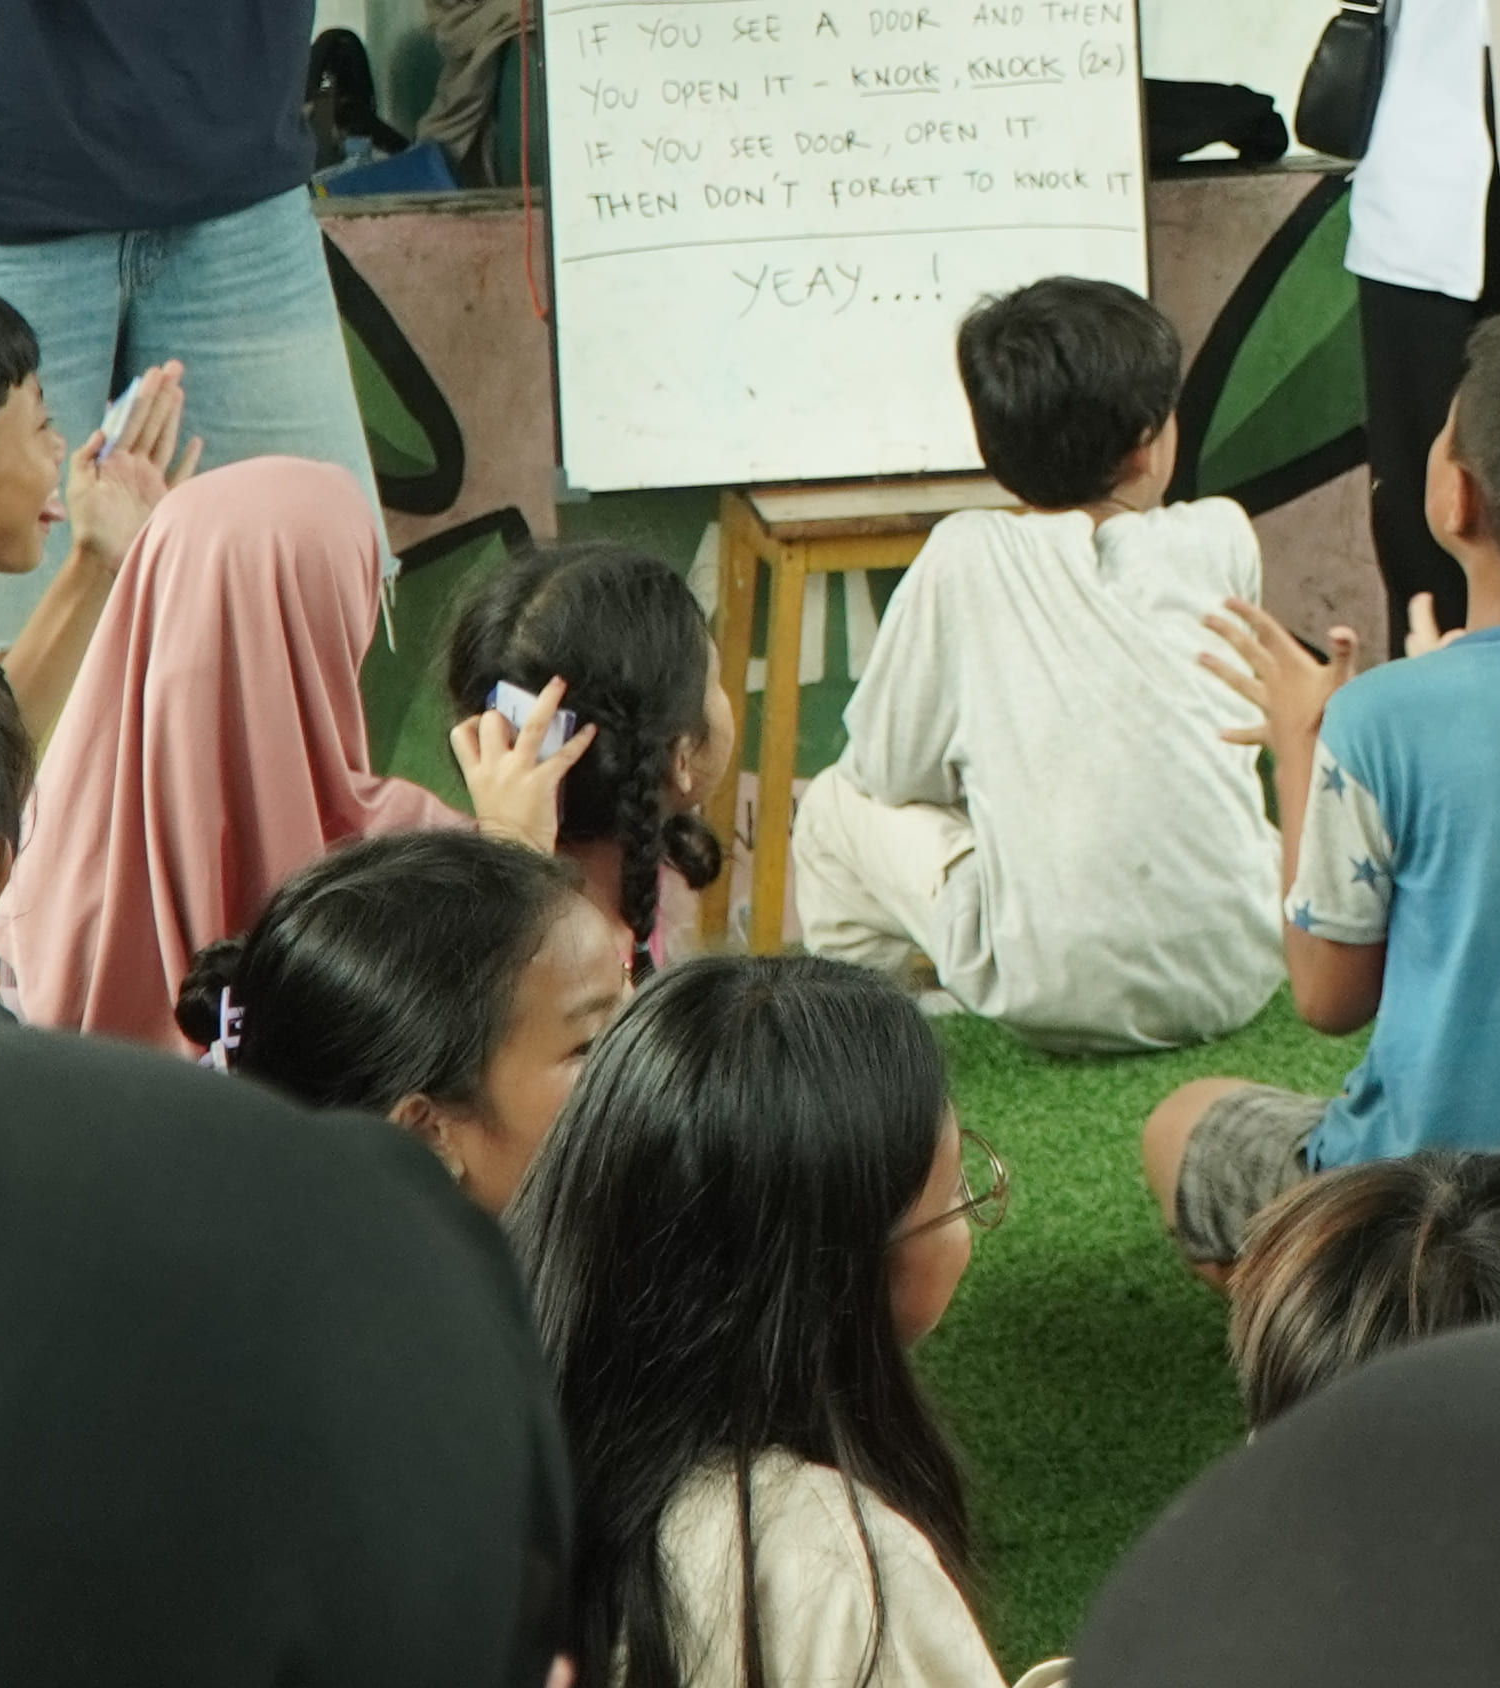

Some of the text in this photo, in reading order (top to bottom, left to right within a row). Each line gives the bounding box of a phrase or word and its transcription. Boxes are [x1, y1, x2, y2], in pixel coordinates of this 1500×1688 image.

[578, 1, 1124, 59] IF YOU SEE A DOOR AND THEN
[579, 83, 639, 115] YOU
[661, 79, 740, 104] OPEN
[763, 75, 794, 96] IT
[966, 55, 1063, 82] KNOCK
[584, 140, 615, 168] IF
[641, 137, 701, 164] YOU
[729, 136, 774, 159] SEE
[905, 119, 978, 146] OPEN
[1005, 115, 1036, 140] IT
[586, 190, 679, 222] THEN
[704, 172, 799, 209] DON'T
[828, 174, 943, 209] FORGET
[962, 168, 994, 193] TO
[1106, 172, 1133, 199] IT
